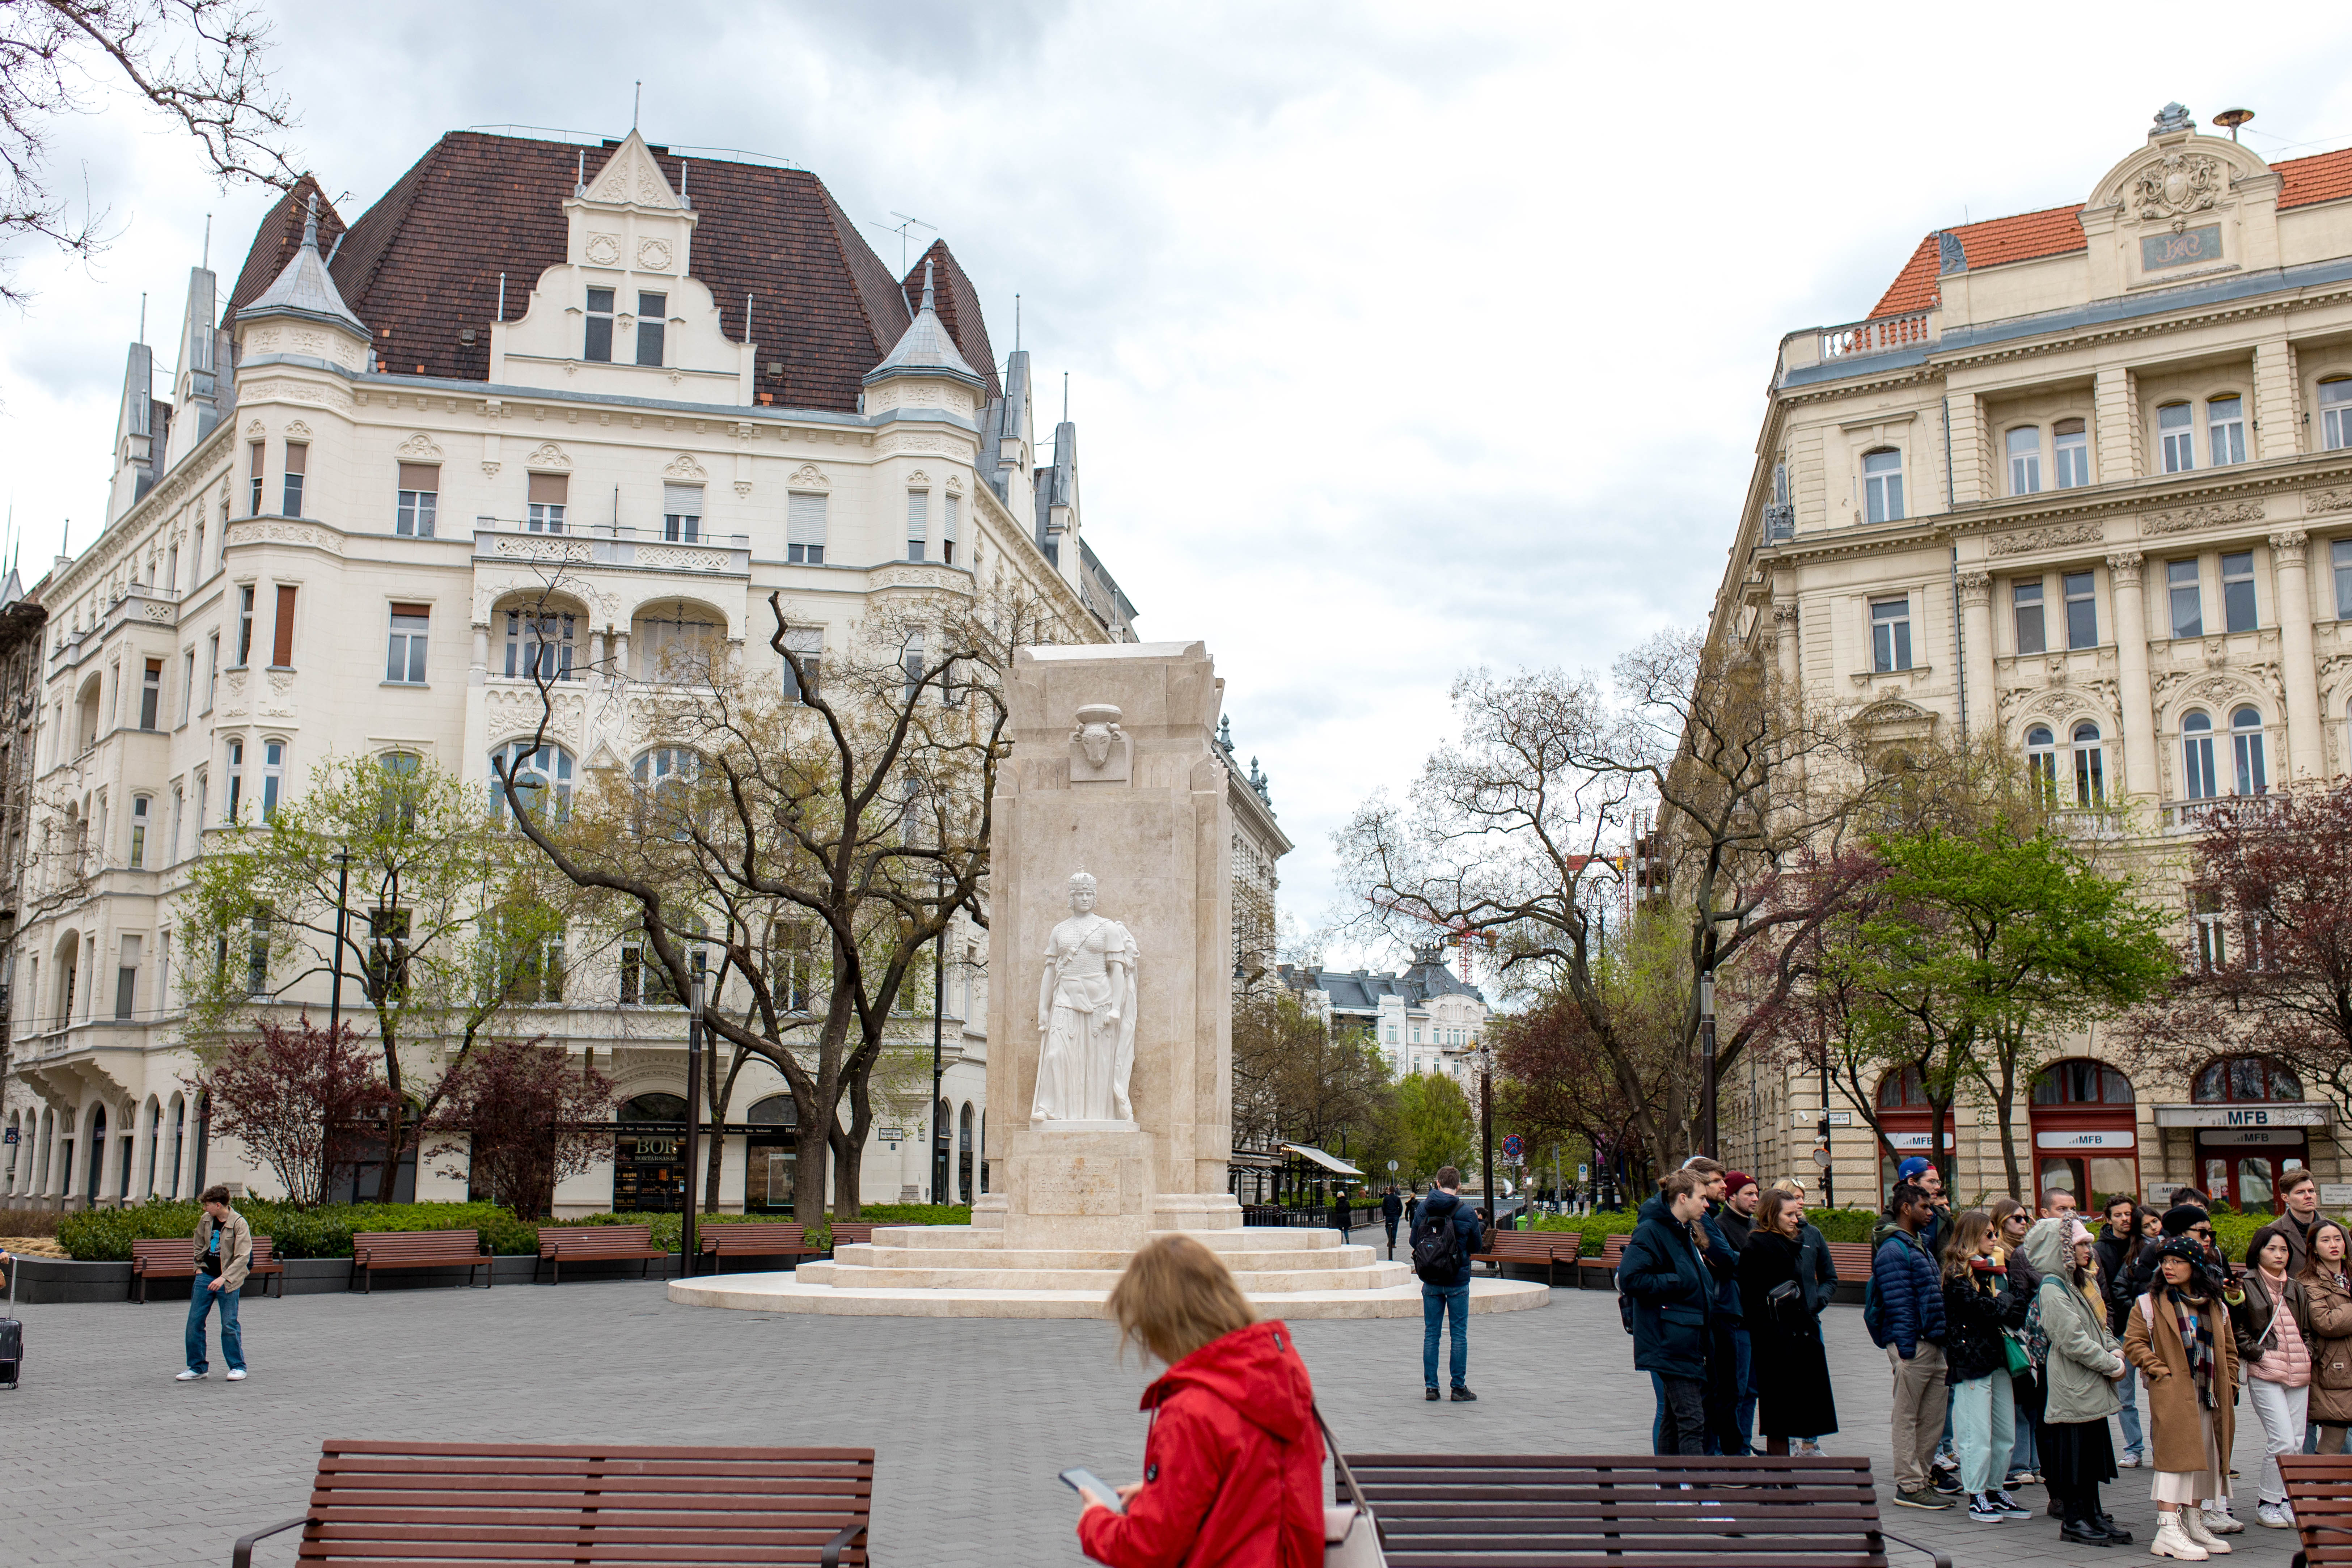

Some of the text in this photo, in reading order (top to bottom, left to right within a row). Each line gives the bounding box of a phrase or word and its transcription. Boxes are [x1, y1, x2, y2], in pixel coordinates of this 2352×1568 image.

[2228, 1111, 2268, 1124] MFB
[2079, 1136, 2102, 1144] MFB
[2245, 1133, 2269, 1142] MFB
[635, 1139, 678, 1154] BOR
[1038, 1164, 1109, 1176] A NEMZET
